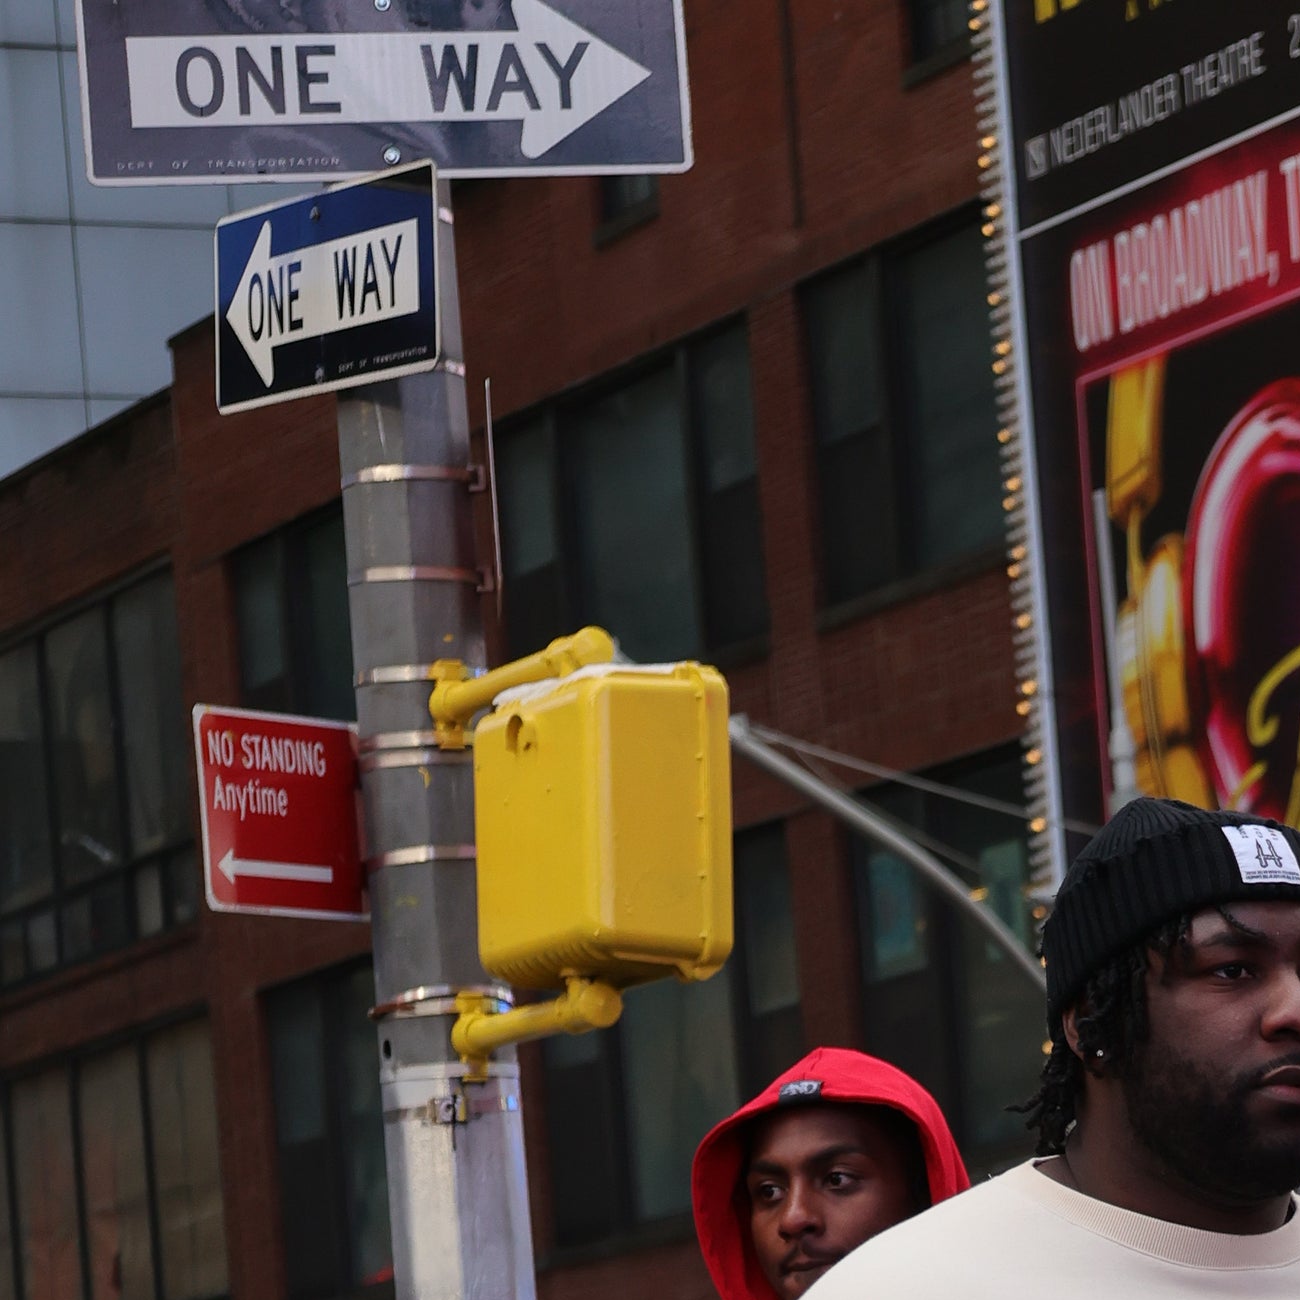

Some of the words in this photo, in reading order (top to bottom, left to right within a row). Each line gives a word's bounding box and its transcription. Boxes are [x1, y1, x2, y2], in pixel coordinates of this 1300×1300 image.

[176, 46, 342, 117] ONE
[420, 42, 590, 112] WAY
[1050, 72, 1180, 165] NEDERLANDER
[1180, 31, 1267, 106] THEATRE
[116, 160, 154, 171] DEPT
[172, 160, 190, 170] OF
[206, 157, 342, 169] TRANSPORTATION
[248, 260, 304, 344] ONE
[333, 234, 404, 320] WAY
[1070, 240, 1114, 352] ON
[1114, 169, 1279, 335] BROADWAY,
[208, 730, 235, 767] NO
[241, 733, 326, 777] STANDING
[213, 773, 289, 820] Anytime
